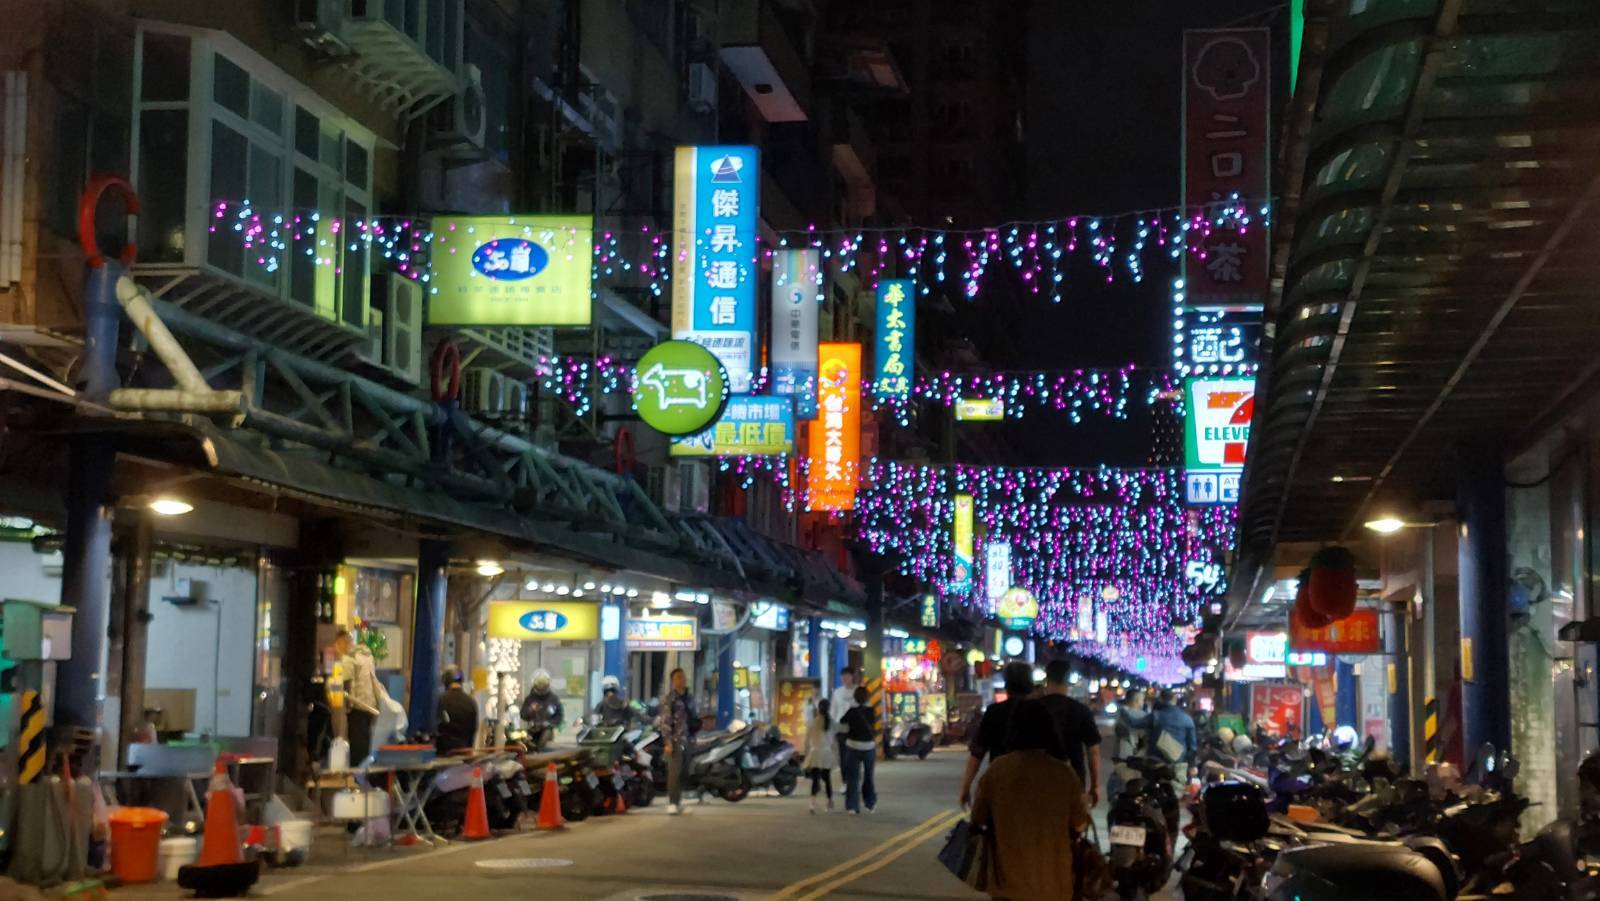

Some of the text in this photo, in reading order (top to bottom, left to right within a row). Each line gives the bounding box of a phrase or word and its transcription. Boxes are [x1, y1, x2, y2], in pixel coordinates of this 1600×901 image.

[709, 188, 740, 326] 傑昇通信
[790, 309, 801, 352] 中華電信
[883, 283, 907, 376] 華太書局
[716, 421, 786, 446] 最低價
